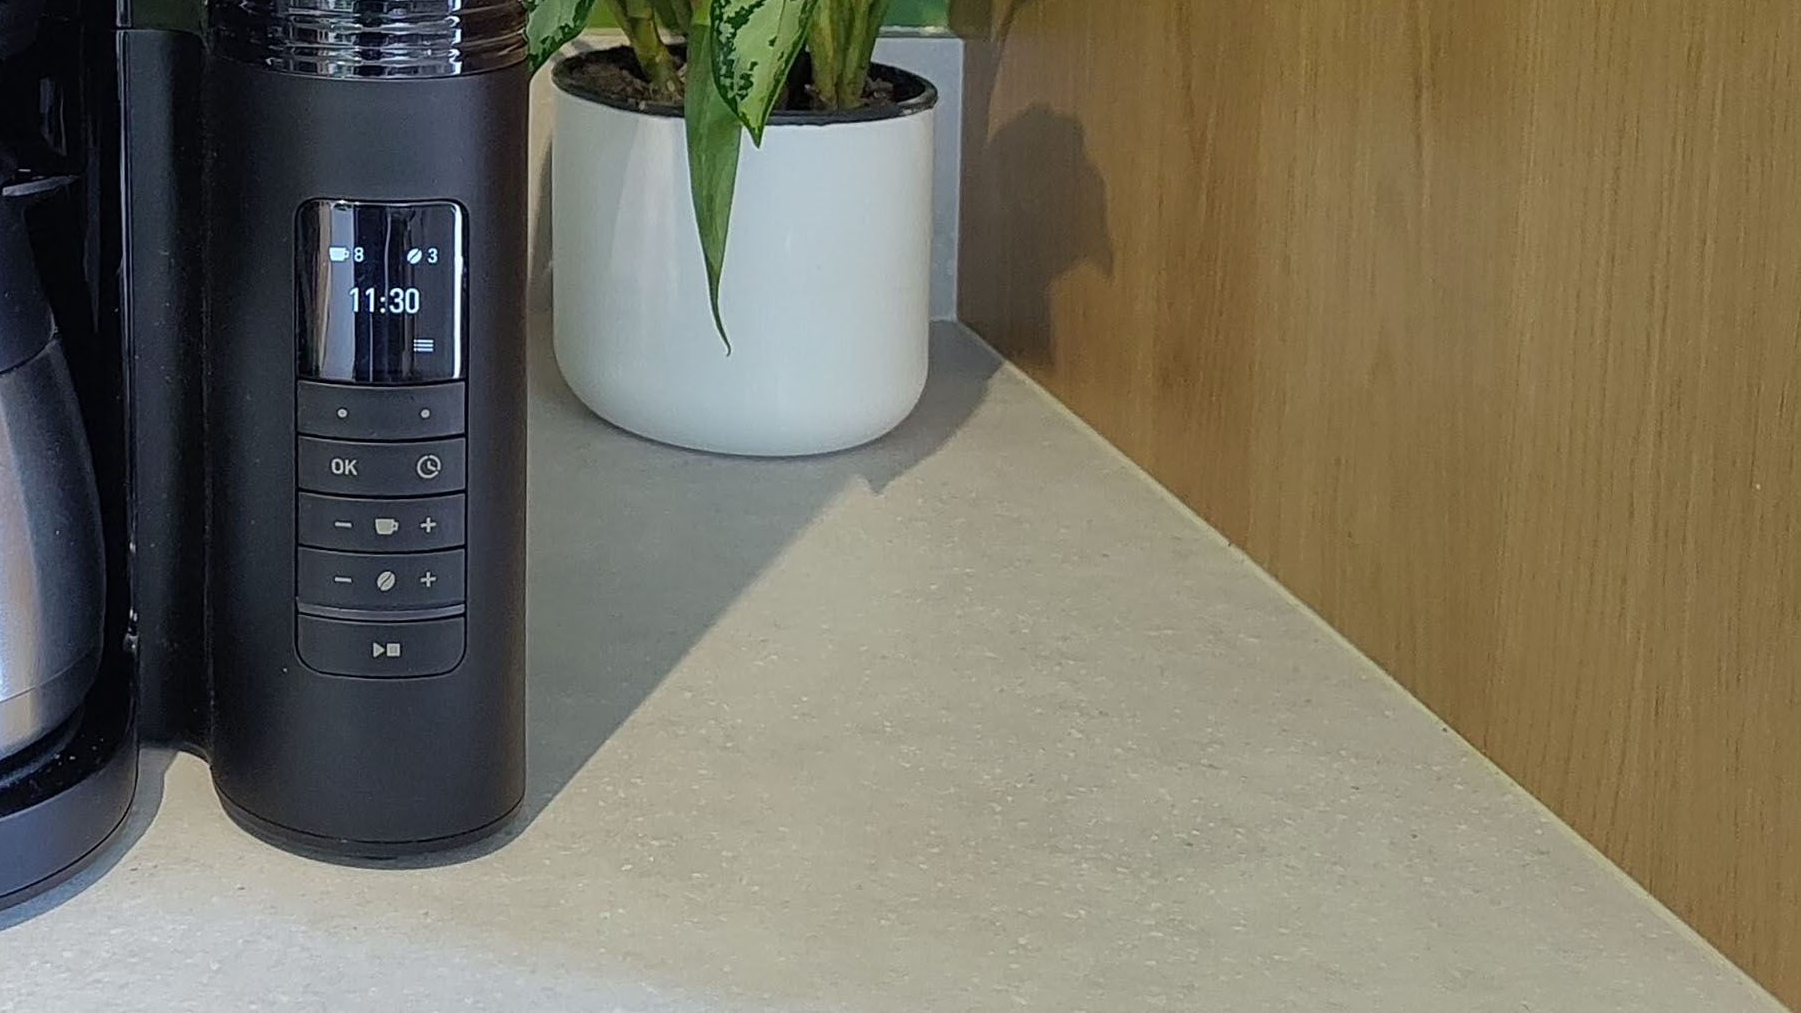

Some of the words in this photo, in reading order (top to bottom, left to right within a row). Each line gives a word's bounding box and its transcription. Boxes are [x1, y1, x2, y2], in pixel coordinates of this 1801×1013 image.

[354, 247, 364, 262] 8
[427, 248, 438, 263] 3
[349, 287, 420, 313] 11:30
[331, 458, 358, 476] OK
